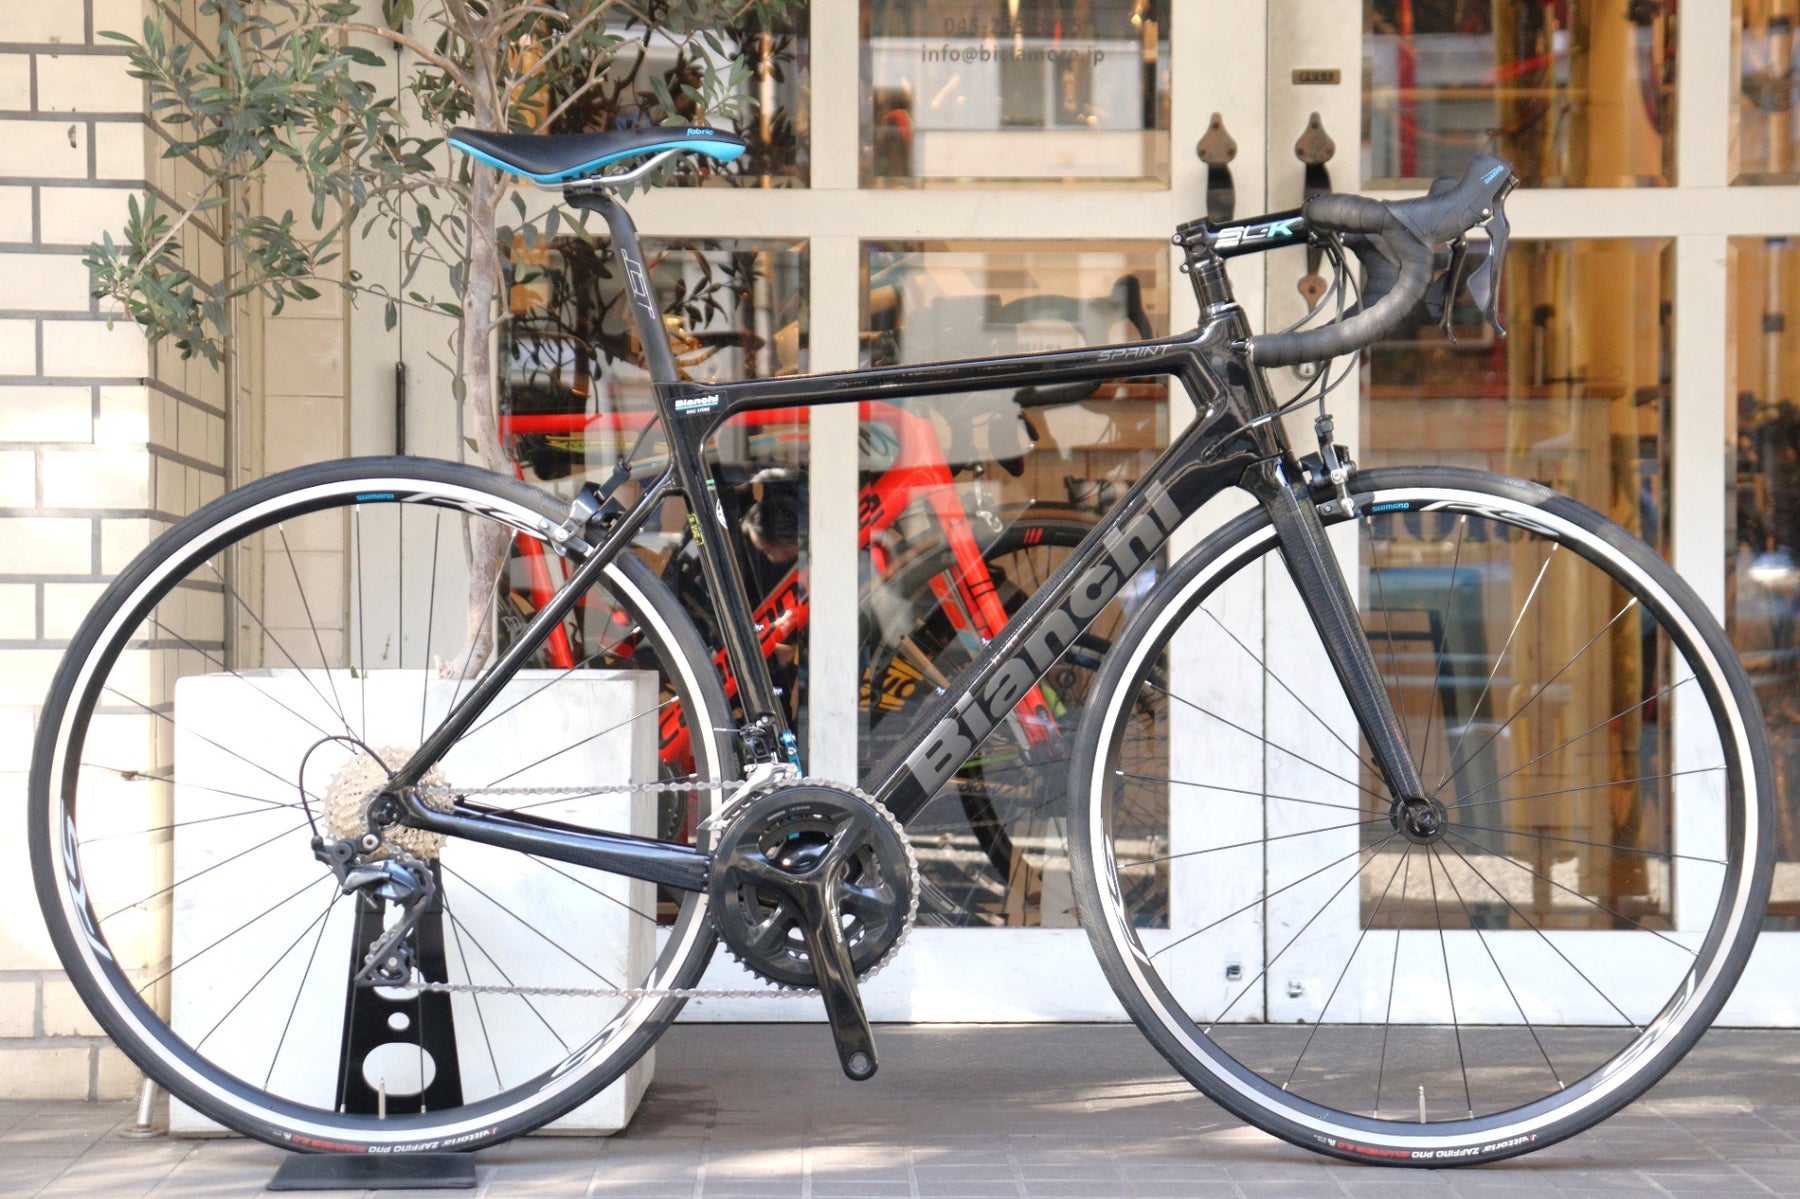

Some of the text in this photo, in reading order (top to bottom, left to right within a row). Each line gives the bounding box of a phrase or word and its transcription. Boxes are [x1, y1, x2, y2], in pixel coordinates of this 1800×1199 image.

[1097, 344, 1173, 361] SPRINT
[675, 394, 719, 408] Bianchi
[904, 480, 1183, 797] Bianchi
